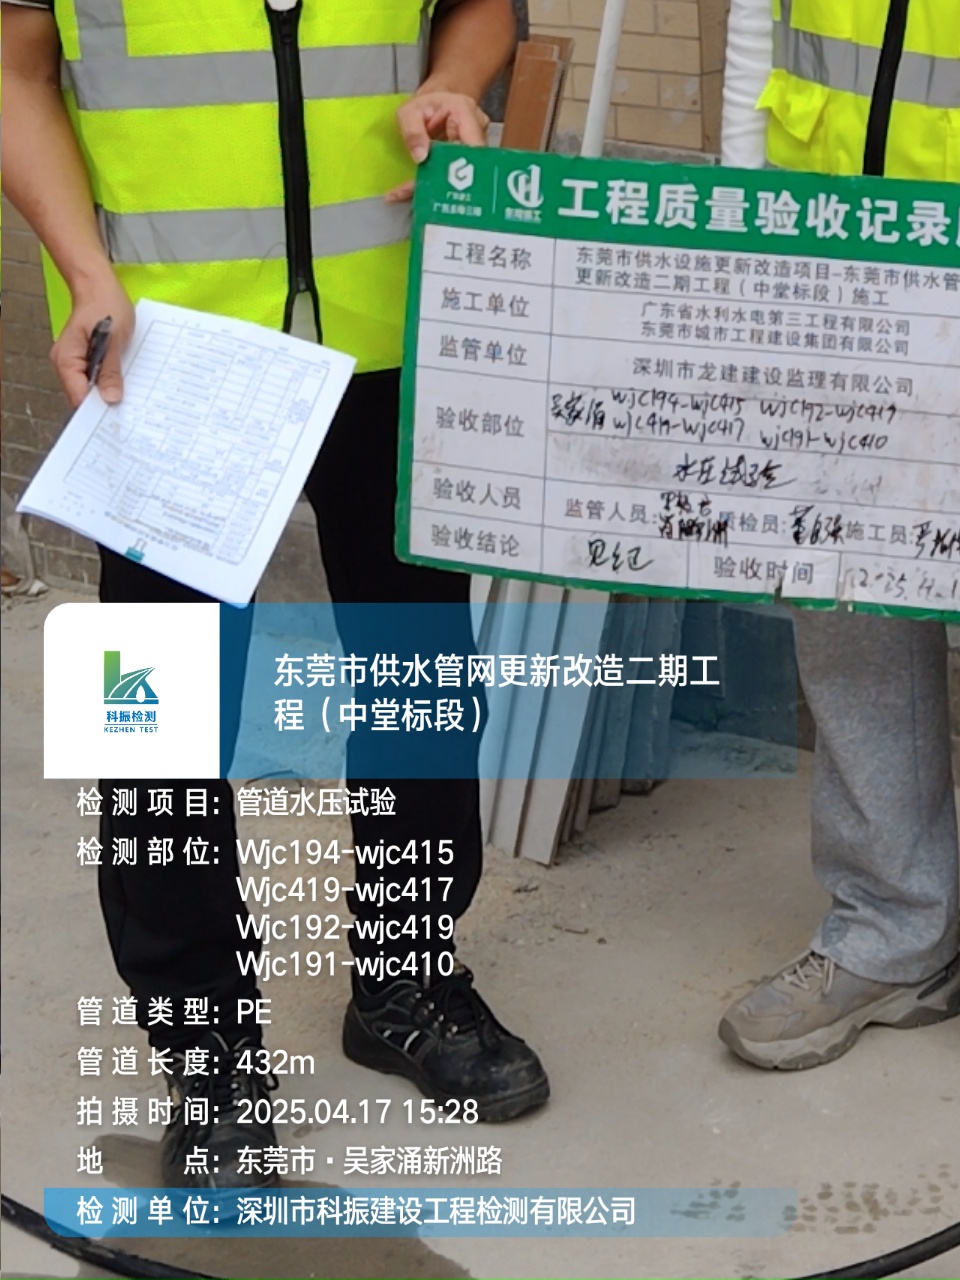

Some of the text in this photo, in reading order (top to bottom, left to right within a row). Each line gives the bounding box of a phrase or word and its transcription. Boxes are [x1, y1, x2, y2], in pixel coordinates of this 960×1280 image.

[444, 241, 532, 270] 工程名称
[441, 287, 530, 318] 施工单位
[575, 268, 890, 307] 更新改造二期工程（中堂标段）施工
[640, 302, 911, 337] 广东省水利水电第三工程有限公司
[438, 334, 528, 366] 监管单位
[640, 321, 910, 357] 东莞市城市工程建设集团有限公司
[632, 357, 915, 397] 深圳市龙建建设监理有限公司
[435, 405, 525, 439] 验收部位
[433, 477, 521, 510] 验收人员
[431, 523, 520, 558] 验收结论
[714, 556, 815, 587] 验收时间
